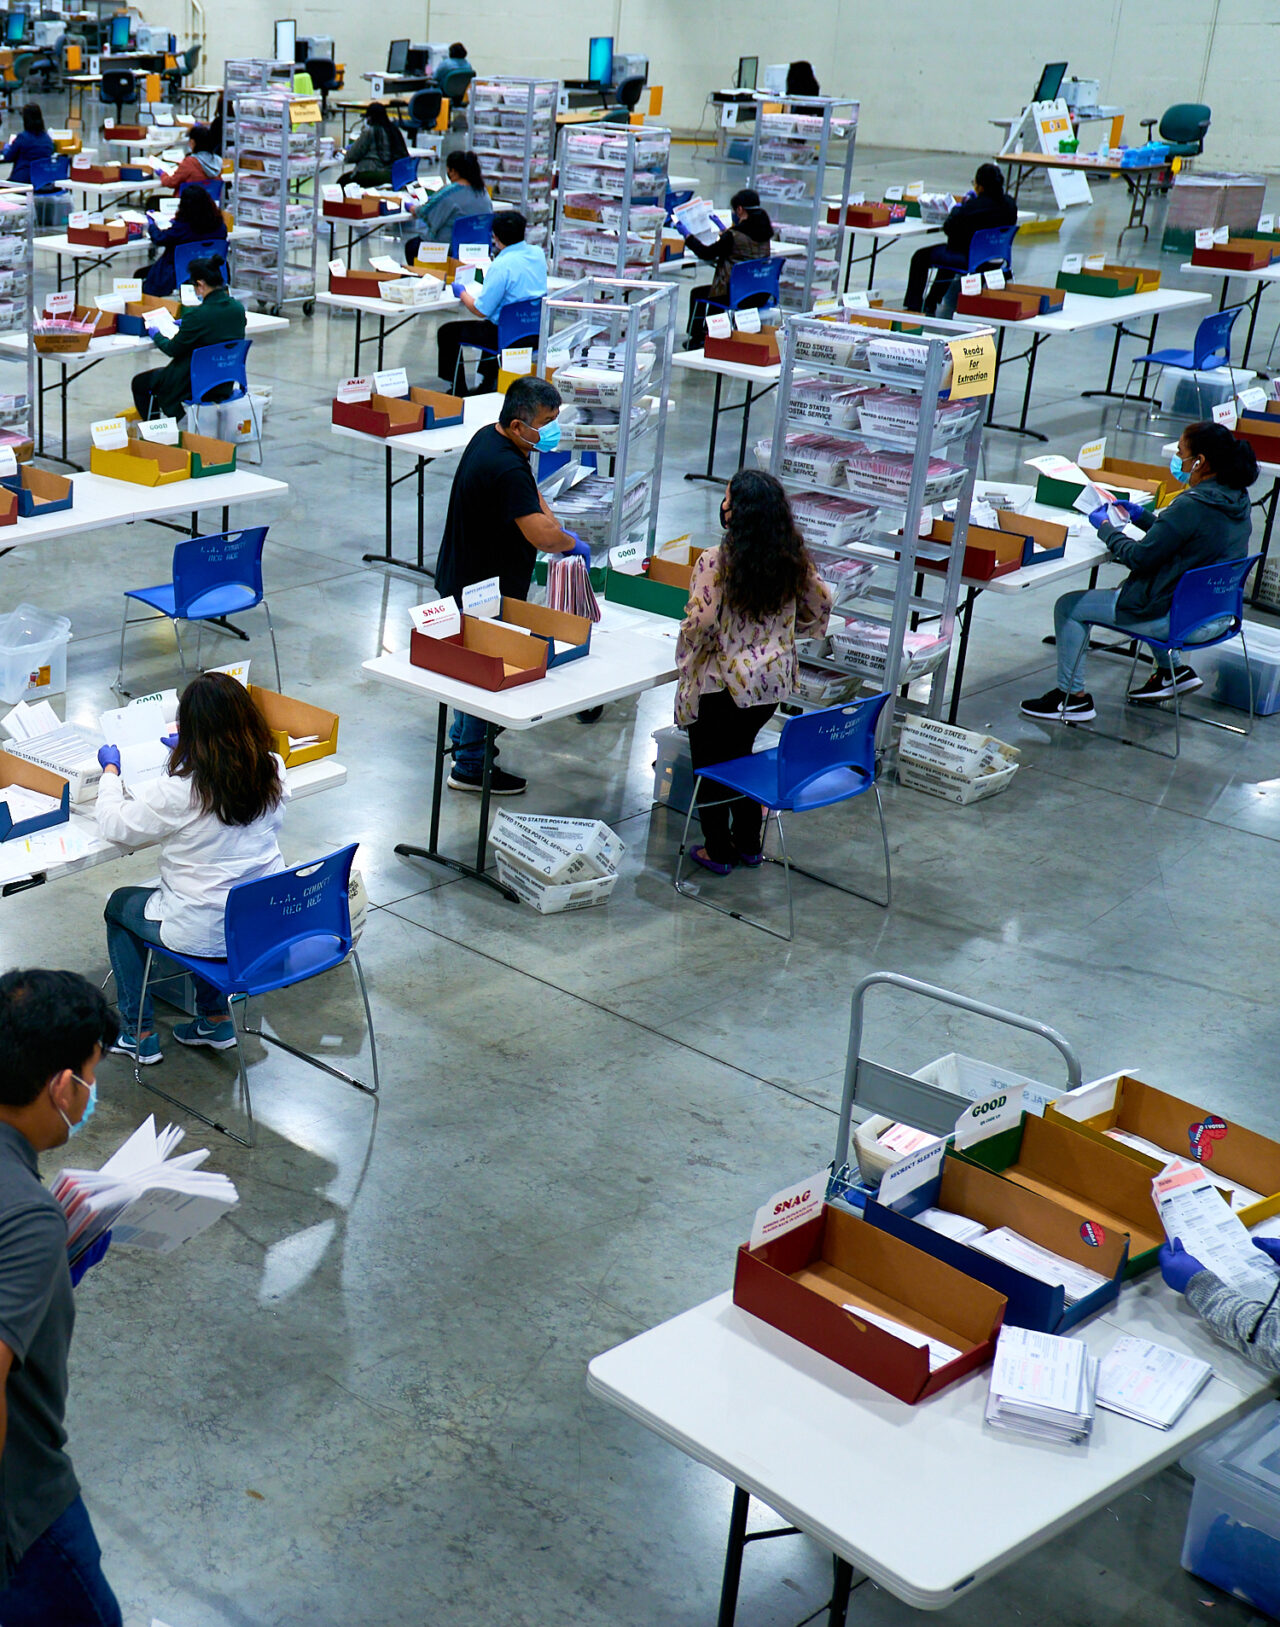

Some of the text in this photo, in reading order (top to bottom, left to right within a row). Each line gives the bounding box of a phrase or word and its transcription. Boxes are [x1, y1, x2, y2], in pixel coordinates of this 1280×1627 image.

[812, 342, 834, 353] STATES
[963, 345, 984, 357] Ready
[811, 350, 837, 361] SERVICE
[969, 358, 980, 369] For
[957, 370, 988, 384] Extraction
[808, 403, 831, 413] STATES
[807, 410, 833, 421] SERVICE
[149, 422, 169, 432] GOOD
[793, 461, 815, 471] STATES
[792, 467, 818, 478] SERVICE
[617, 548, 637, 558] GOOD
[422, 604, 446, 617] SNAG
[844, 655, 868, 666] POSTAL
[847, 650, 870, 660] UNITED
[920, 722, 967, 741] UNITED STATES
[6, 747, 23, 757] UNITED
[22, 753, 40, 763] STATES
[40, 759, 58, 771] POSTAL
[498, 811, 514, 824] UNITED
[513, 820, 531, 834] STATES
[531, 830, 550, 846] POSTAL
[549, 841, 572, 857] SERVICE
[269, 893, 296, 906] L.A.
[303, 875, 332, 898] COUNTY
[282, 902, 302, 916] REG
[972, 1095, 1007, 1118] GOOD
[773, 1189, 811, 1216] SNAG
